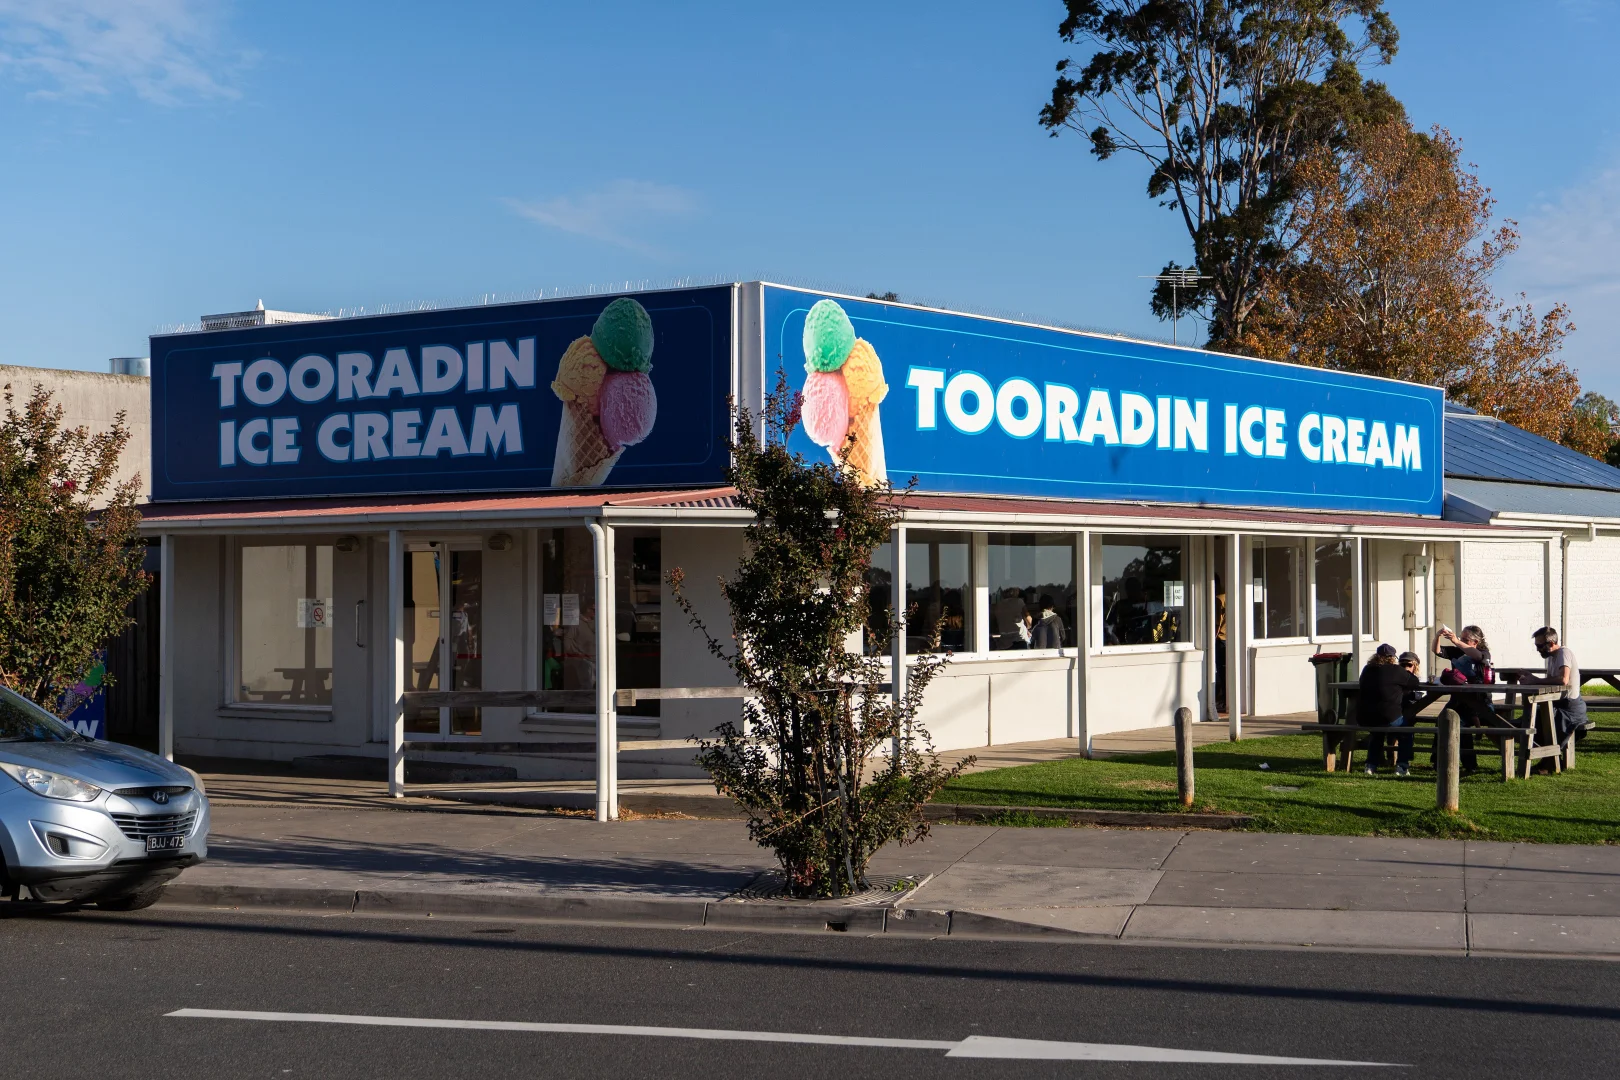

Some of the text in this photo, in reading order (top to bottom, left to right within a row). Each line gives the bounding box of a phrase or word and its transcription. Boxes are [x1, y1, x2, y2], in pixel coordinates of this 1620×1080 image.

[211, 336, 537, 409] TOORADIN
[219, 402, 524, 467] ICE CREAM
[906, 365, 1423, 473] TOORADIN ICE CREAM
